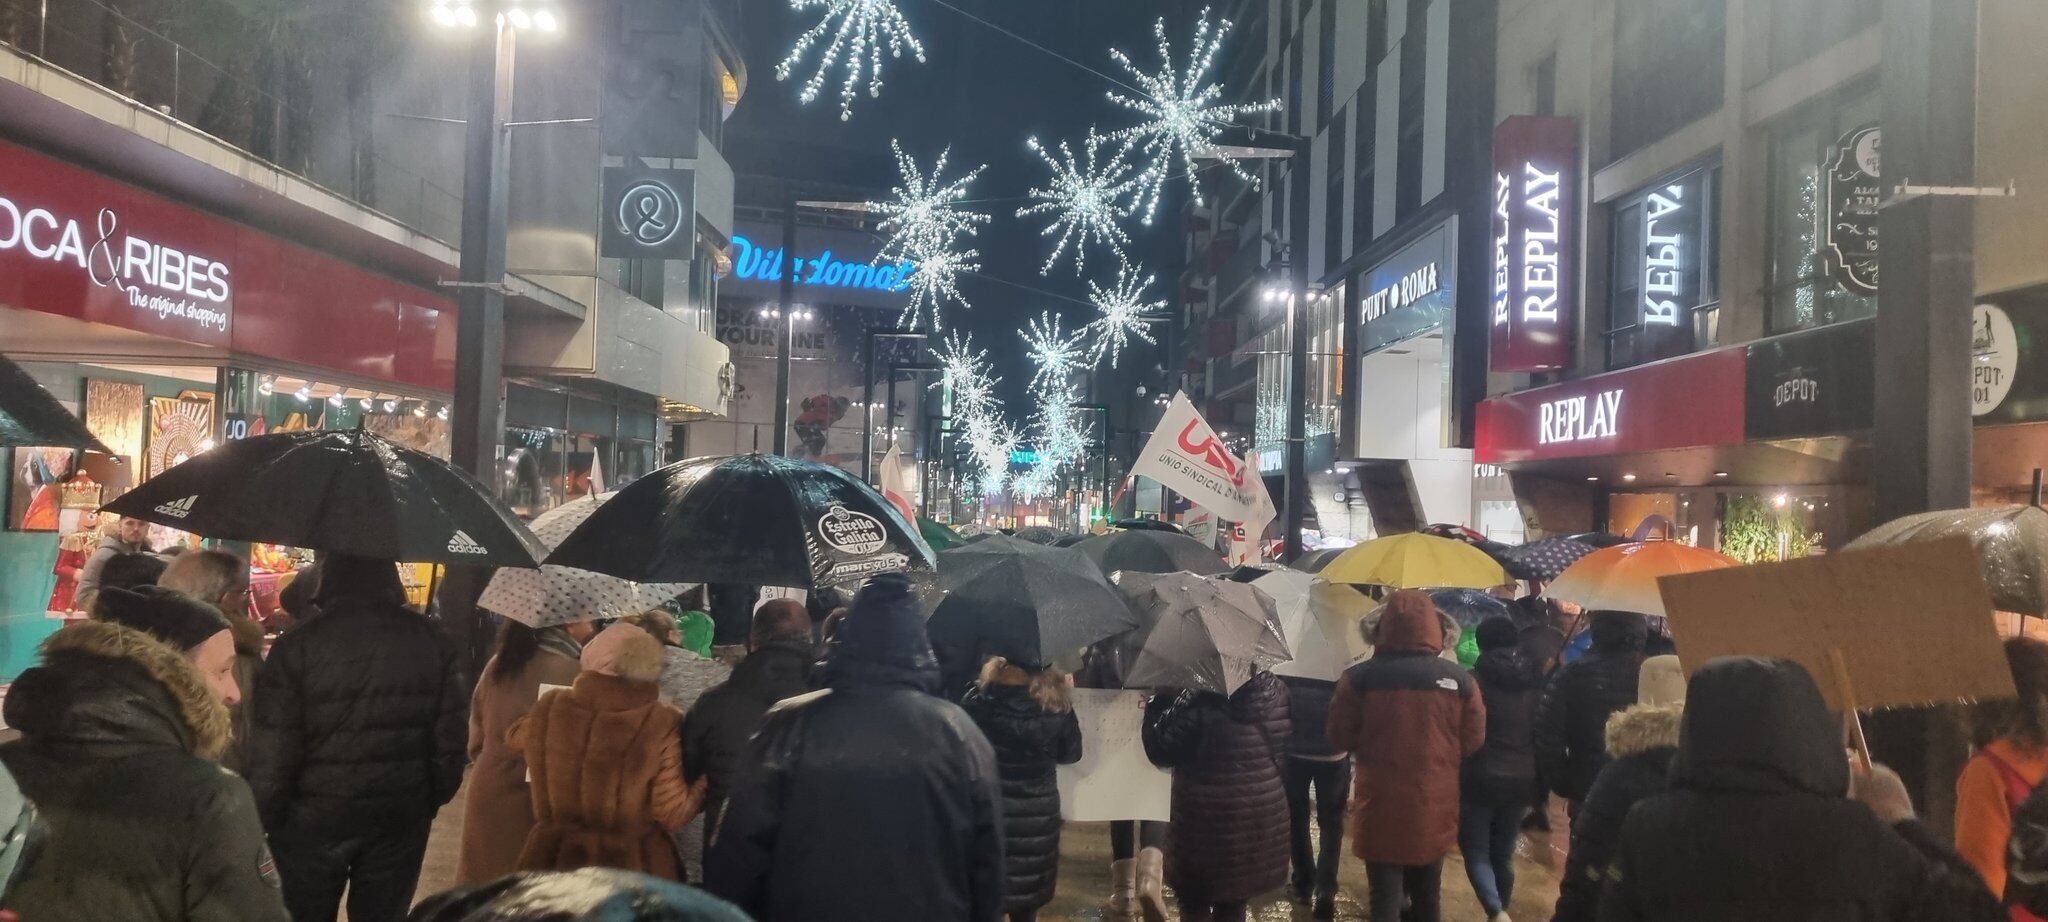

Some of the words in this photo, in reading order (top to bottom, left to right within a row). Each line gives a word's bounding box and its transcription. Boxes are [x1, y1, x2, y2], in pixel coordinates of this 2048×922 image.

[1495, 171, 1509, 327] REPLAY
[1524, 161, 1559, 322] REPLAY
[127, 286, 148, 306] The
[150, 295, 186, 320] original
[187, 301, 227, 332] shopping
[1361, 287, 1389, 326] PUNT
[1401, 262, 1438, 307] ROMA
[1539, 389, 1624, 445] REPLAY
[1182, 466, 1223, 495] SINDICAL
[154, 504, 190, 519] adidas
[825, 518, 875, 533] Estrella
[447, 543, 488, 556] adidas
[834, 529, 880, 545] Galicia
